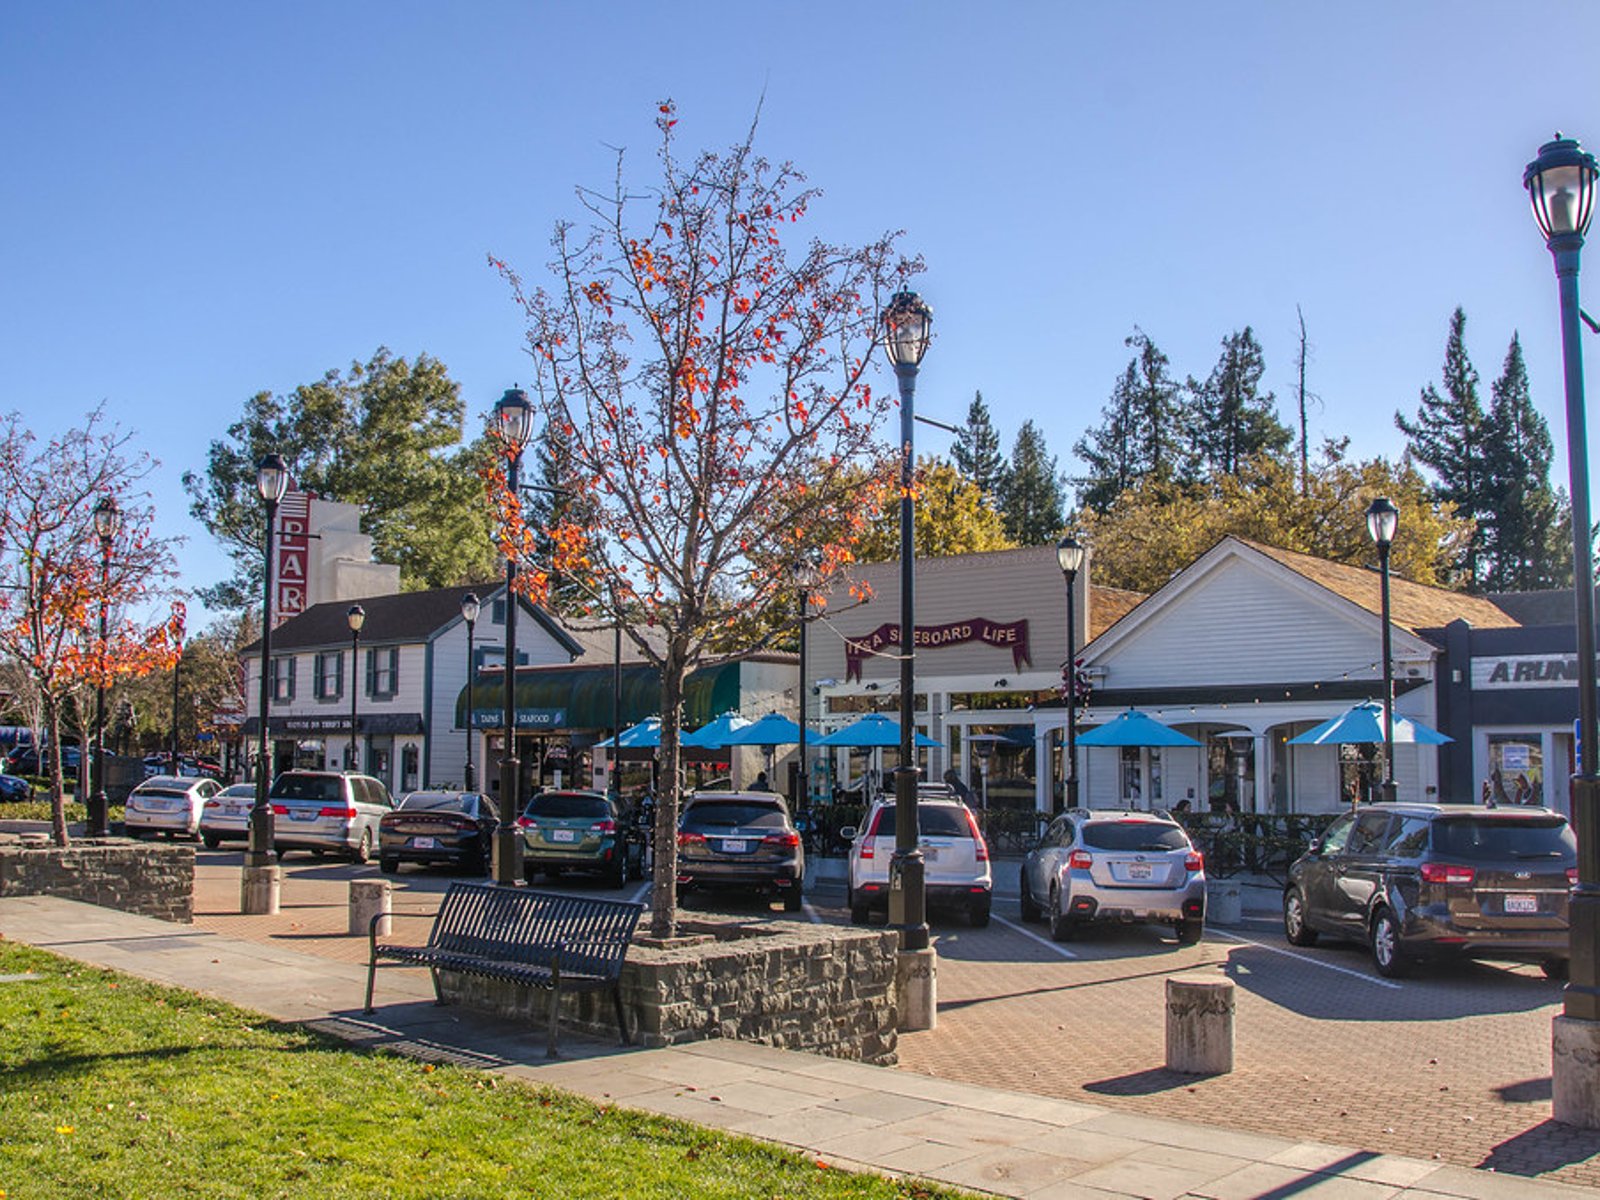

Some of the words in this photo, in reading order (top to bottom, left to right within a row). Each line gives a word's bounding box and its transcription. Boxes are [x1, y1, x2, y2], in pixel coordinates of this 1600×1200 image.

[280, 520, 304, 619] PAR
[873, 634, 883, 647] A
[889, 625, 972, 644] SIEBOARD
[982, 626, 1016, 642] LIFE
[1513, 659, 1600, 681] RUN
[519, 714, 549, 723] SEAFOOD
